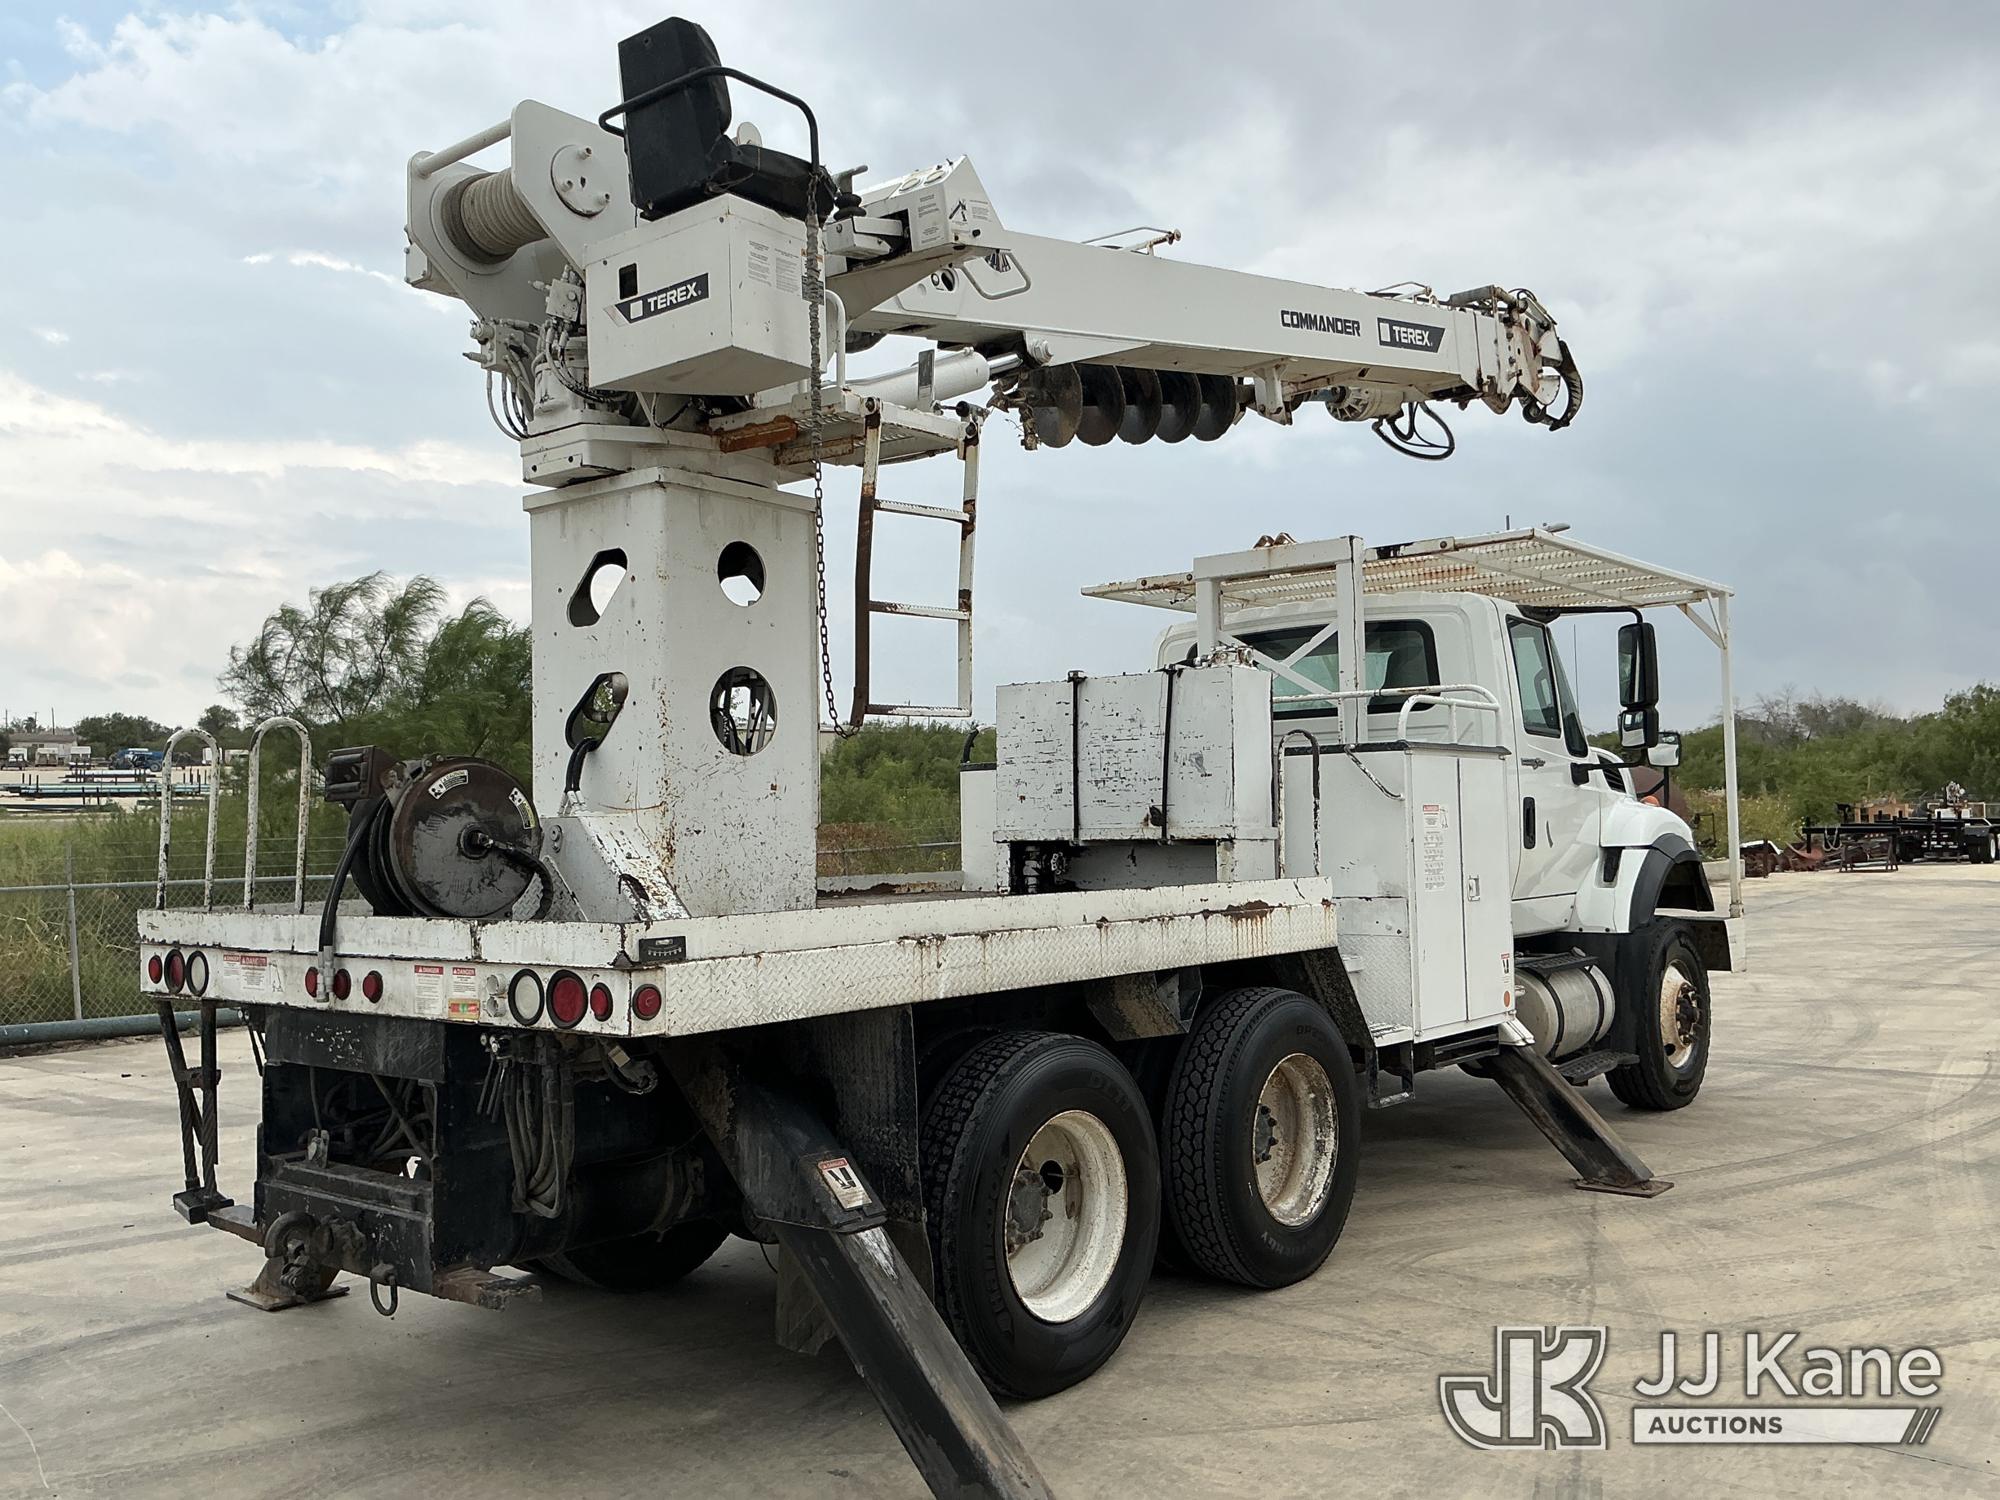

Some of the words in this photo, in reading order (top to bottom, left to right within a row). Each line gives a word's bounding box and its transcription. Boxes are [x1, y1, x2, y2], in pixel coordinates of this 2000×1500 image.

[648, 281, 699, 313] TEREX
[1281, 309, 1361, 337] COMMANDER
[1393, 325, 1431, 347] TEREX
